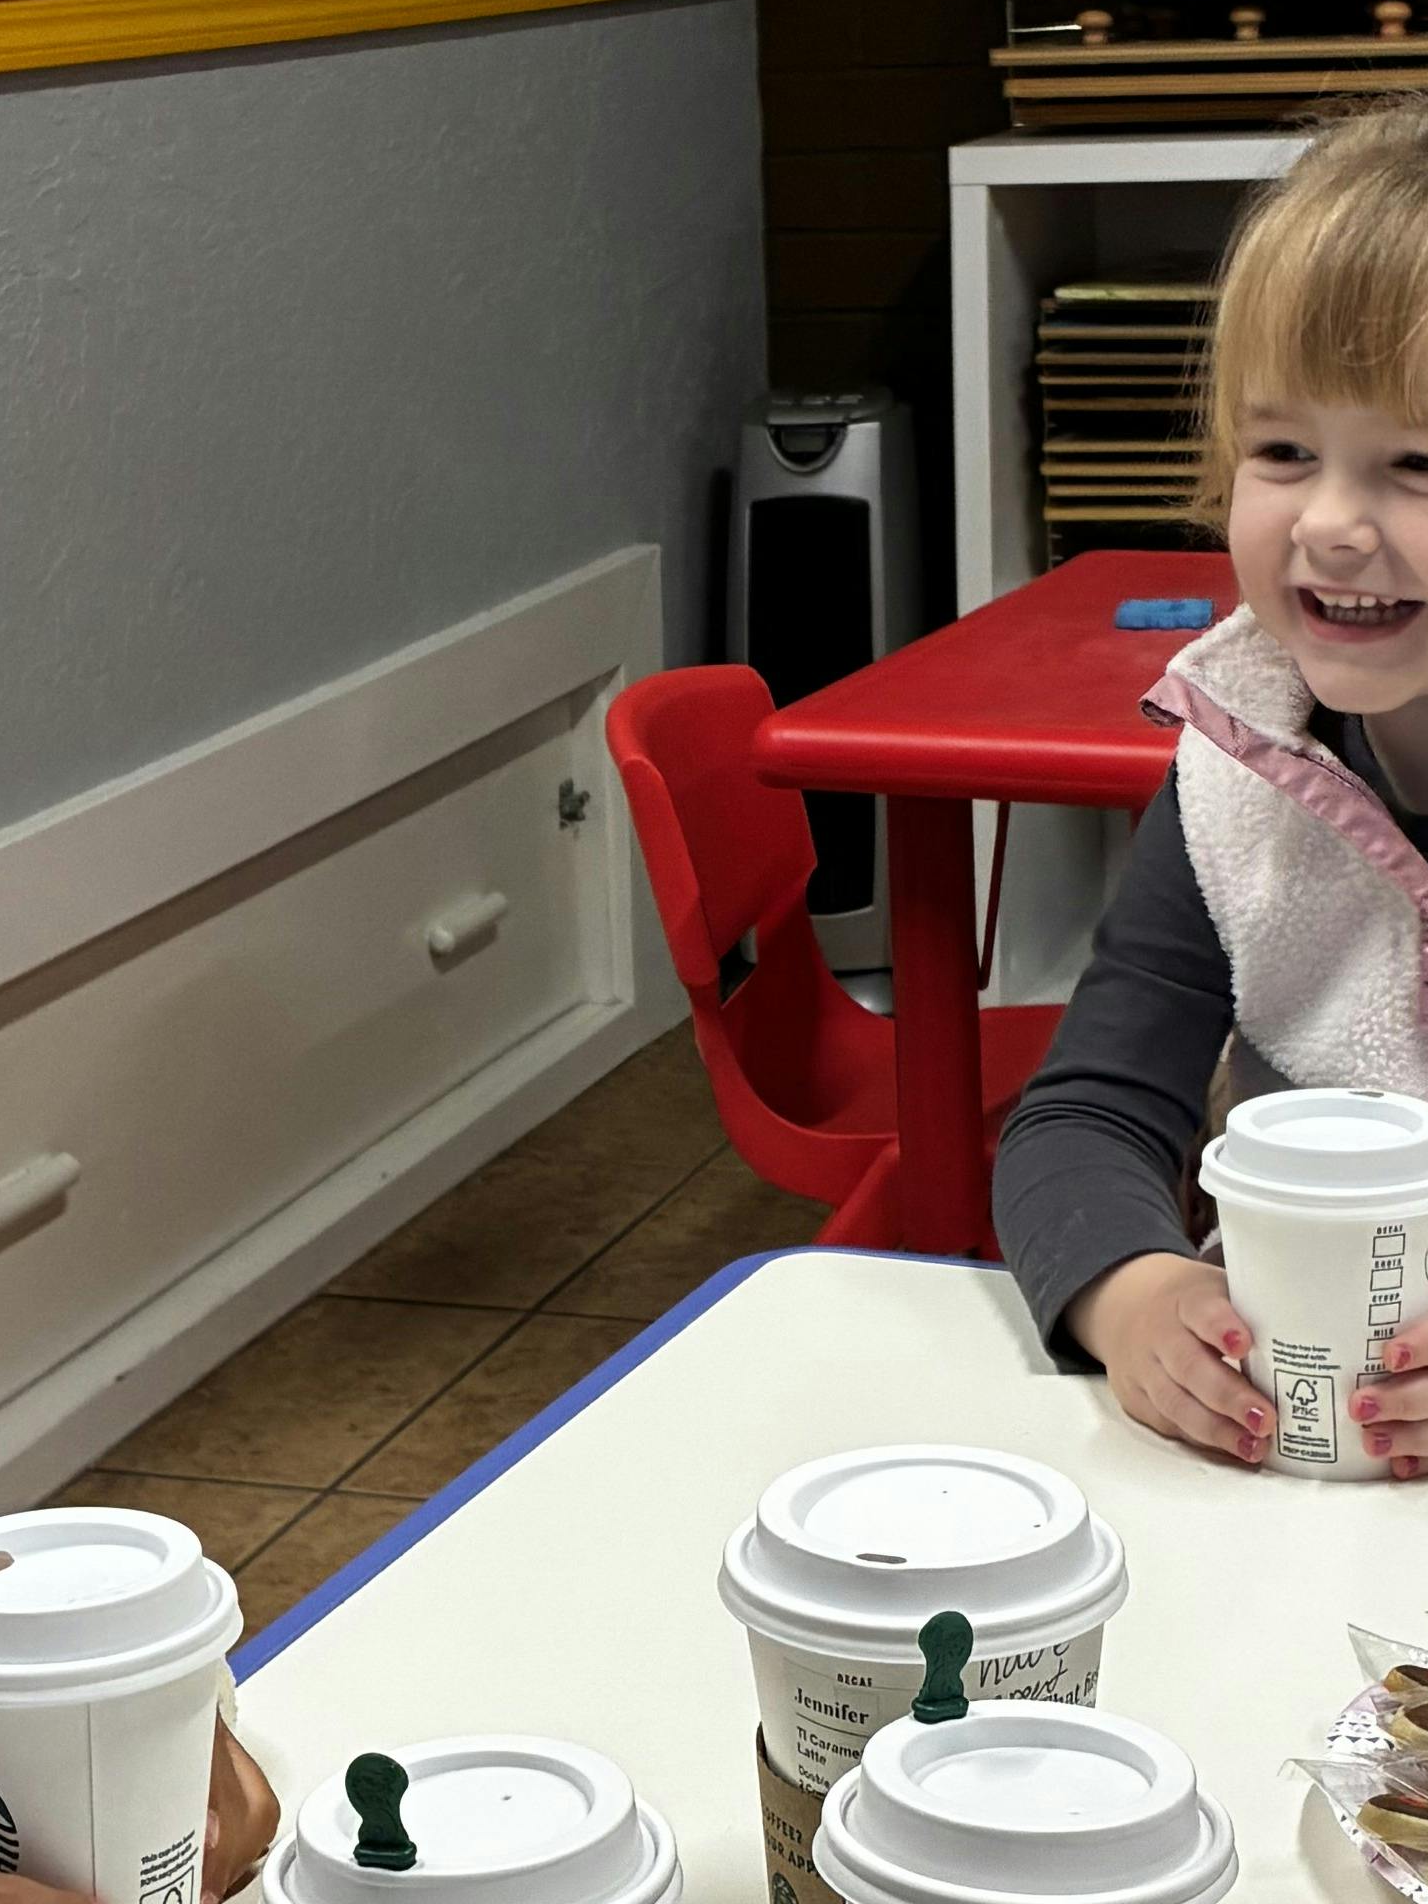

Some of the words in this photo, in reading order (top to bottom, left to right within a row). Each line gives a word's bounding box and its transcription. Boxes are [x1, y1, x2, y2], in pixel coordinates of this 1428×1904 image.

[1373, 1326, 1395, 1338] MILK
[1291, 1404, 1320, 1418] FSC
[836, 1672, 873, 1689] DECAF
[794, 1686, 871, 1726] Jennifer
[797, 1741, 828, 1767] Latte
